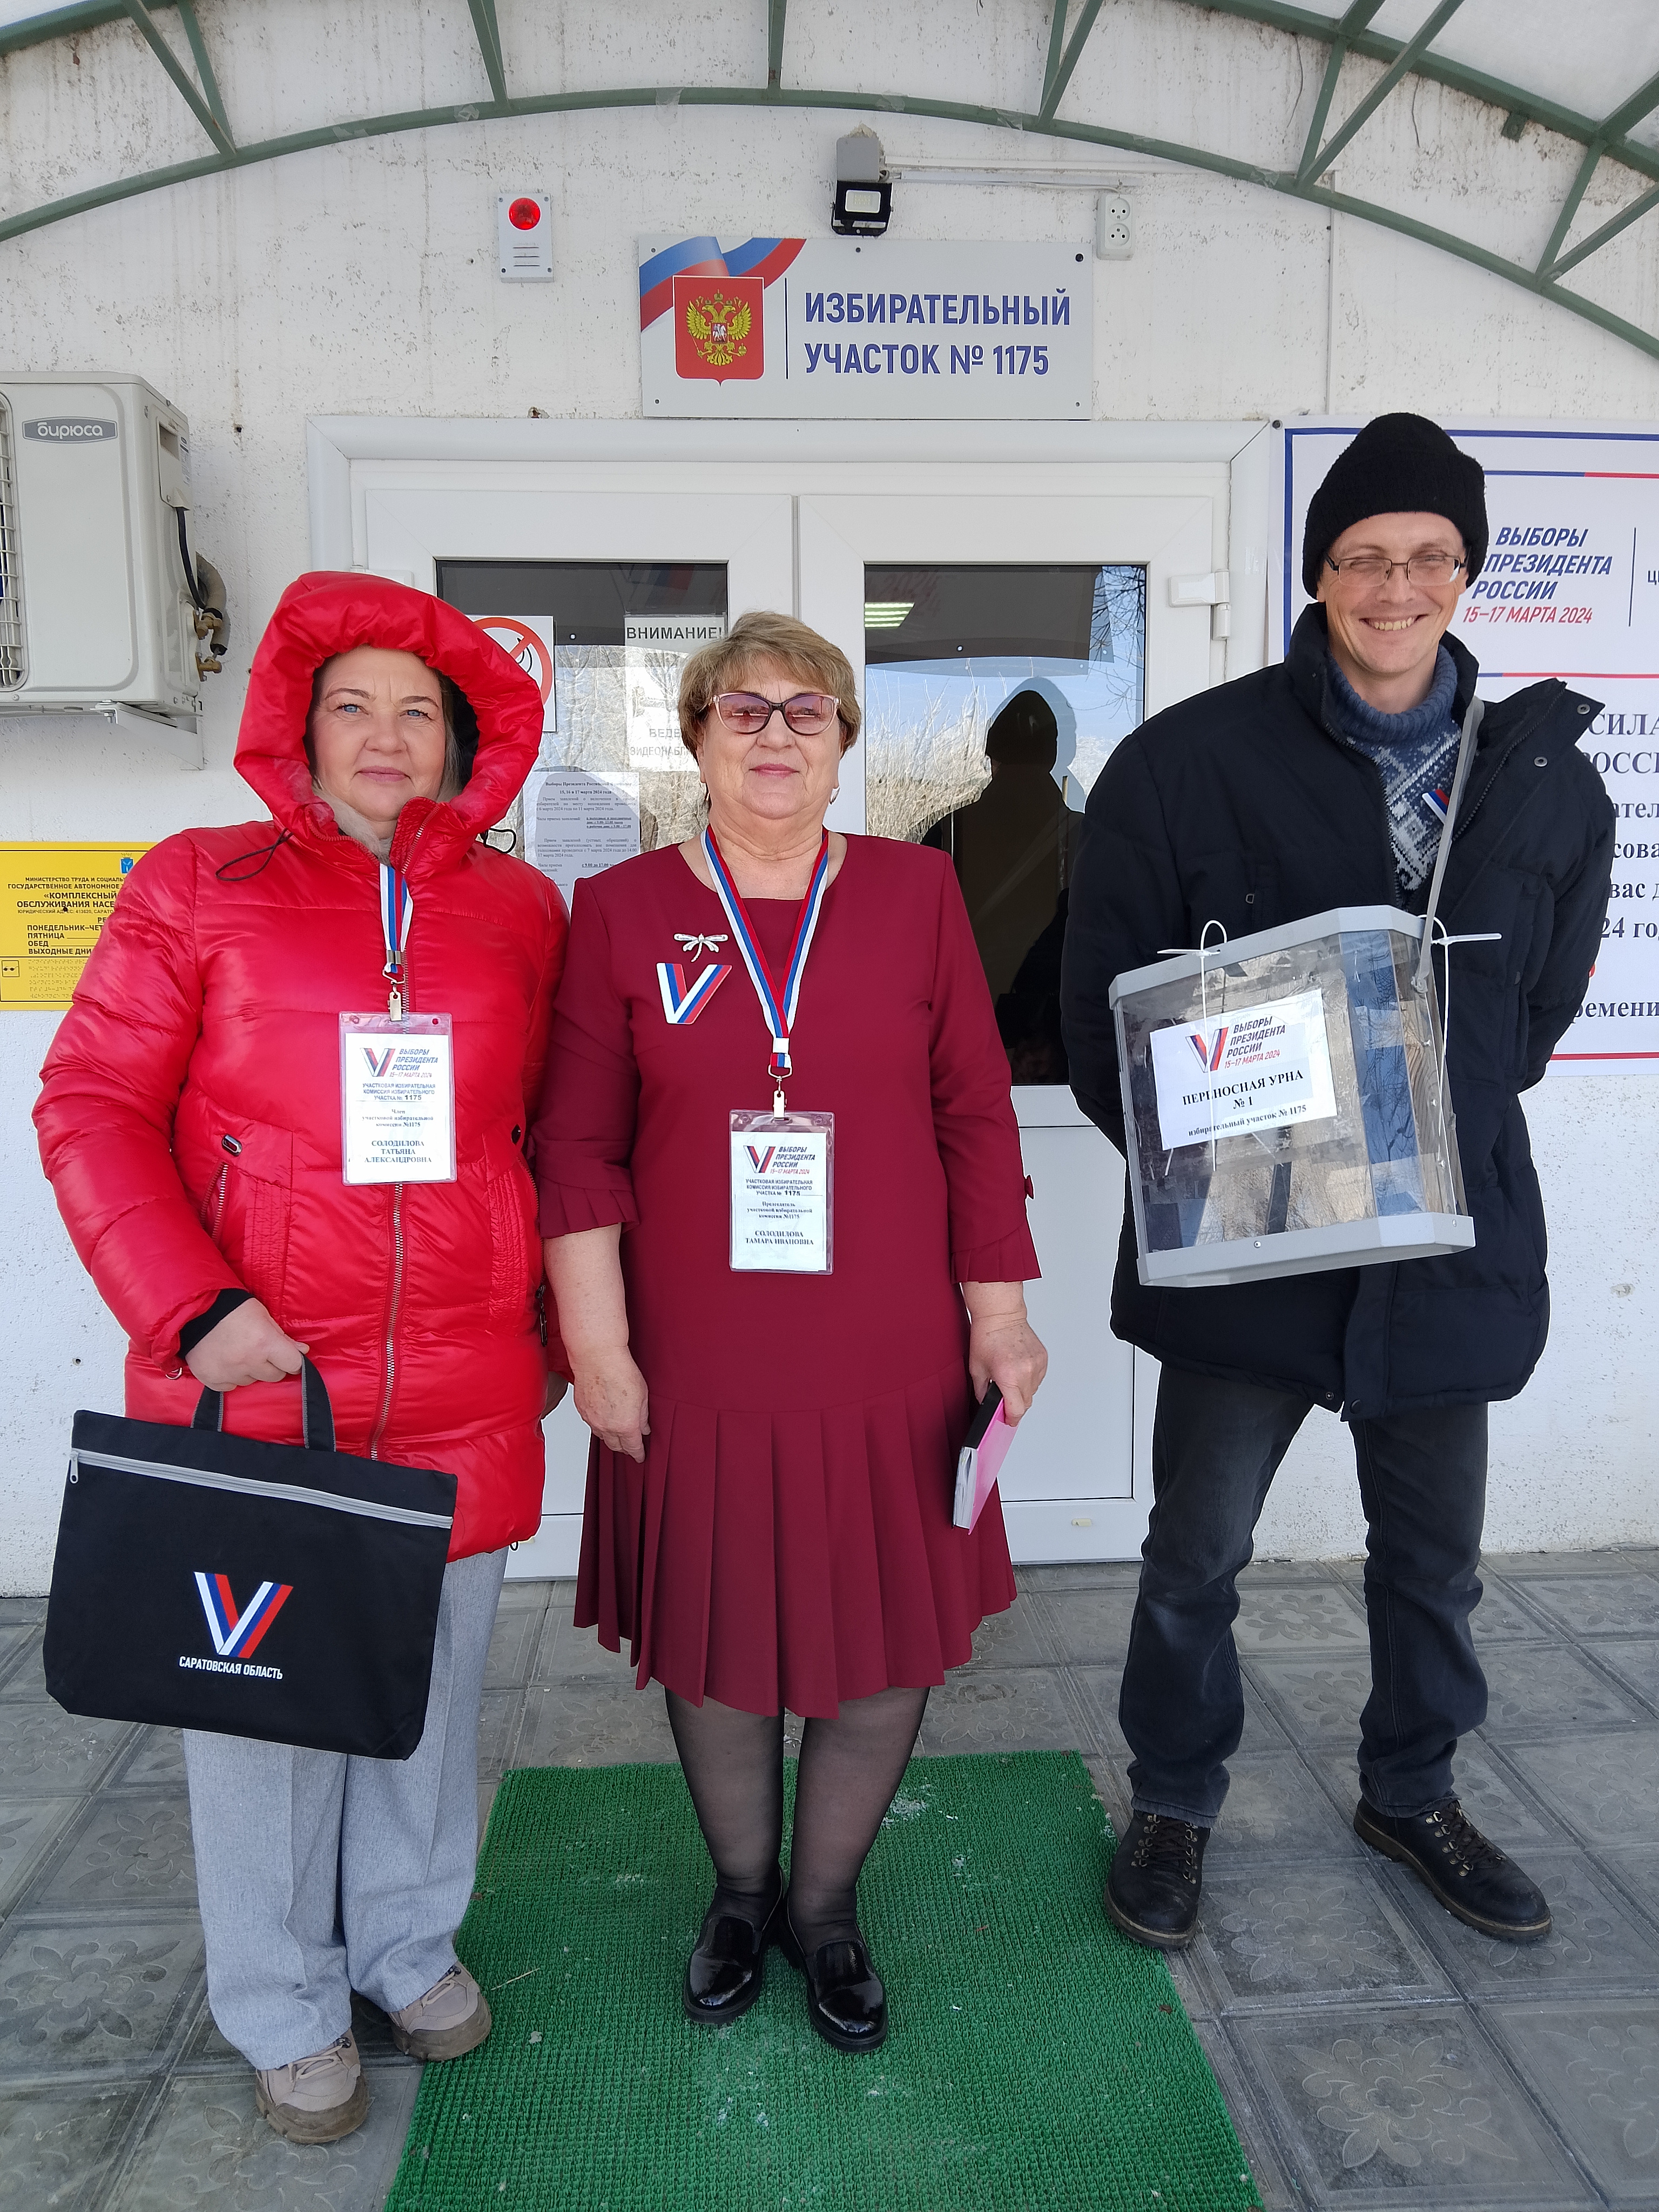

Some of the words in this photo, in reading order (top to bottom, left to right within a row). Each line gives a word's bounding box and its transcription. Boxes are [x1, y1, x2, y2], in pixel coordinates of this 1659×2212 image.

[805, 288, 1070, 326] ИЗБИРАТЕЛЬНЫЙ
[805, 343, 940, 374] УЧАСТОК
[950, 345, 984, 374] №
[993, 346, 1049, 375] 1175
[1495, 527, 1588, 547] ВЫБОРЫ
[1484, 554, 1613, 576] ПРЕЗИДЕНТА
[1472, 581, 1557, 600] РОССИИ
[1506, 607, 1557, 624] МАРТА
[1558, 607, 1593, 624] 2024
[626, 626, 722, 640] ВНИМАНИЕ!
[44, 891, 117, 899] «КОМПЛЕКСНЫЙ
[1233, 1016, 1272, 1034] ВЫБОРЫ
[1230, 1025, 1285, 1046] ПРЕЗИДЕНТА
[1227, 1042, 1262, 1058] РОССИИ
[1242, 1053, 1263, 1065] МАРТА
[1265, 1049, 1280, 1060] 2024
[1269, 1070, 1304, 1086] УРНА
[1233, 1098, 1245, 1109] №
[1249, 1096, 1253, 1105] 1
[1246, 1112, 1277, 1125] участок
[1290, 1105, 1306, 1115] 1175
[179, 1656, 241, 1675] САРАТОВСКАЯ
[243, 1664, 283, 1680] ОБЛАСТЬ
